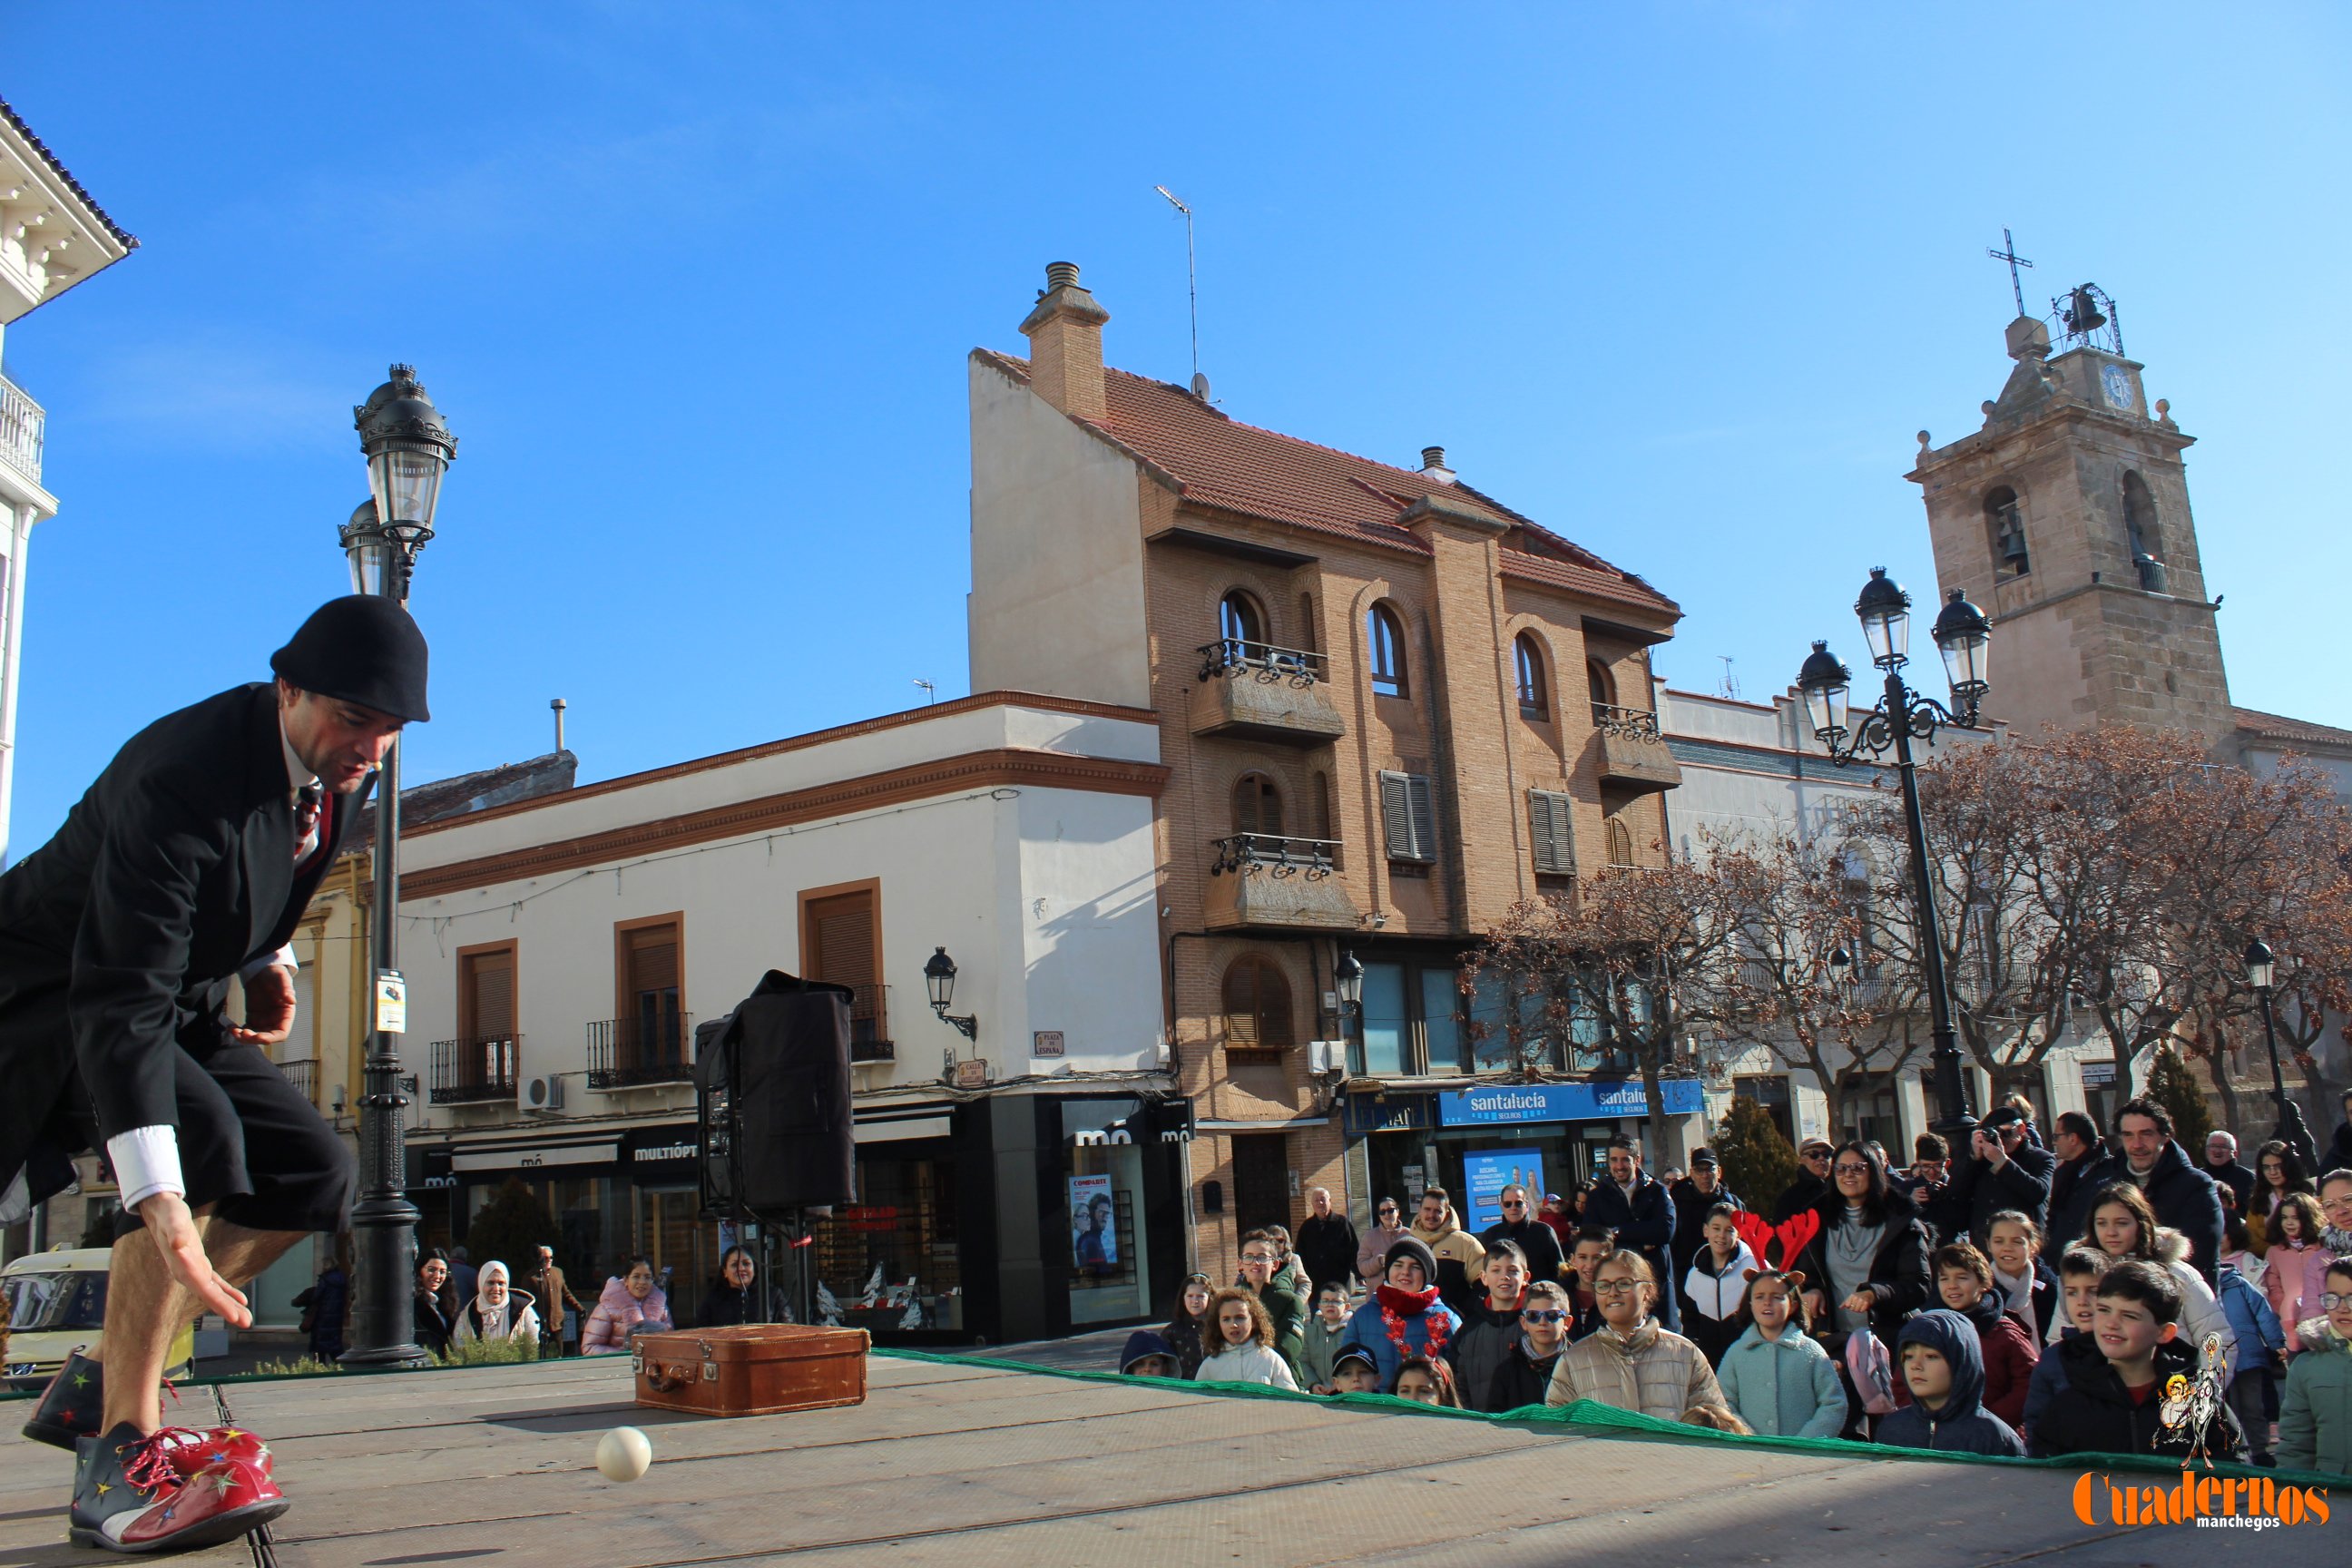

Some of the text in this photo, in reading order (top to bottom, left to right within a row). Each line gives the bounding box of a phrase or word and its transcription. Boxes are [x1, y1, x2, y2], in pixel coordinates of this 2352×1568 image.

[1039, 1046, 1060, 1054] ESPAÑA
[1471, 1093, 1546, 1111] santalucía
[1599, 1089, 1664, 1104] santalu
[1498, 1108, 1522, 1120] SEGUROS
